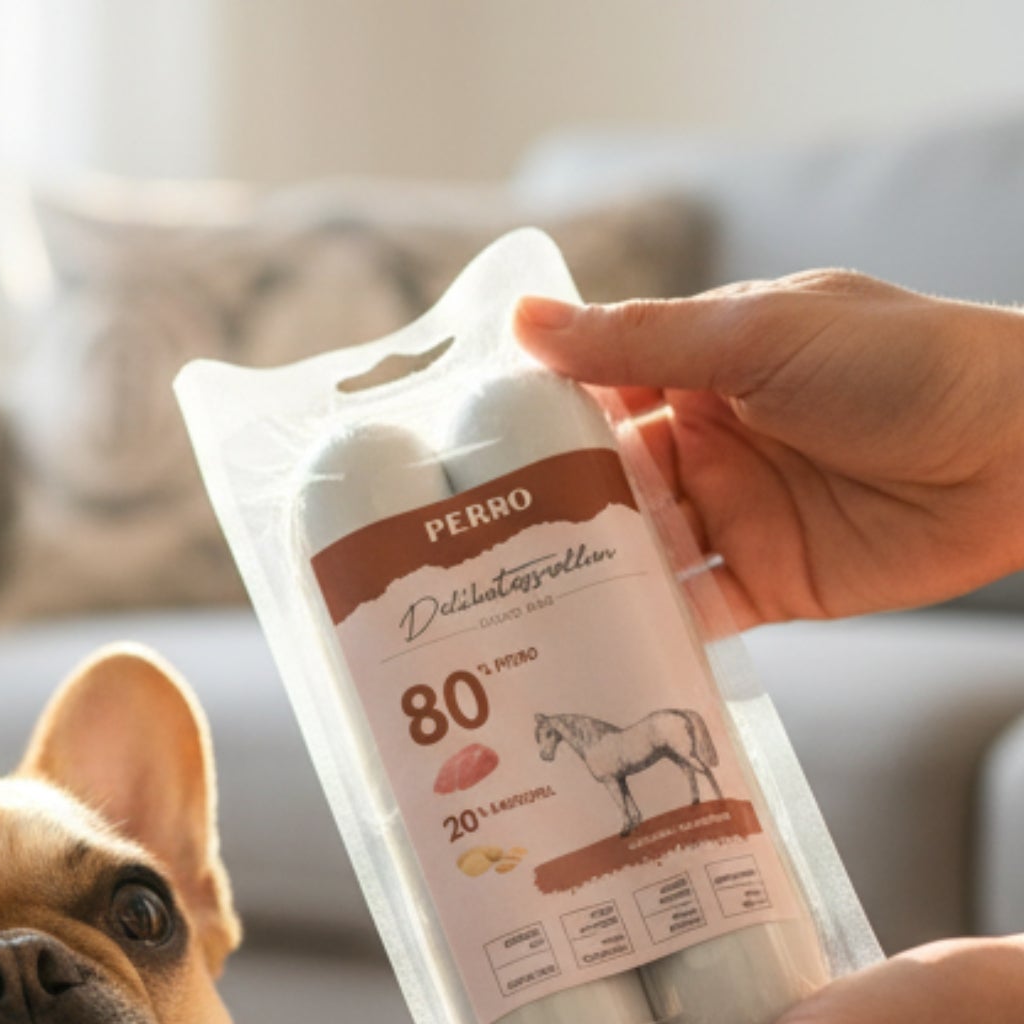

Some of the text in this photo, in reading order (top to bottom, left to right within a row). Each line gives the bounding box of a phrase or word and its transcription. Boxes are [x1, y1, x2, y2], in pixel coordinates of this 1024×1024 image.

[424, 488, 532, 542] PERRO
[401, 670, 489, 746] 80
[443, 809, 479, 843] 20
